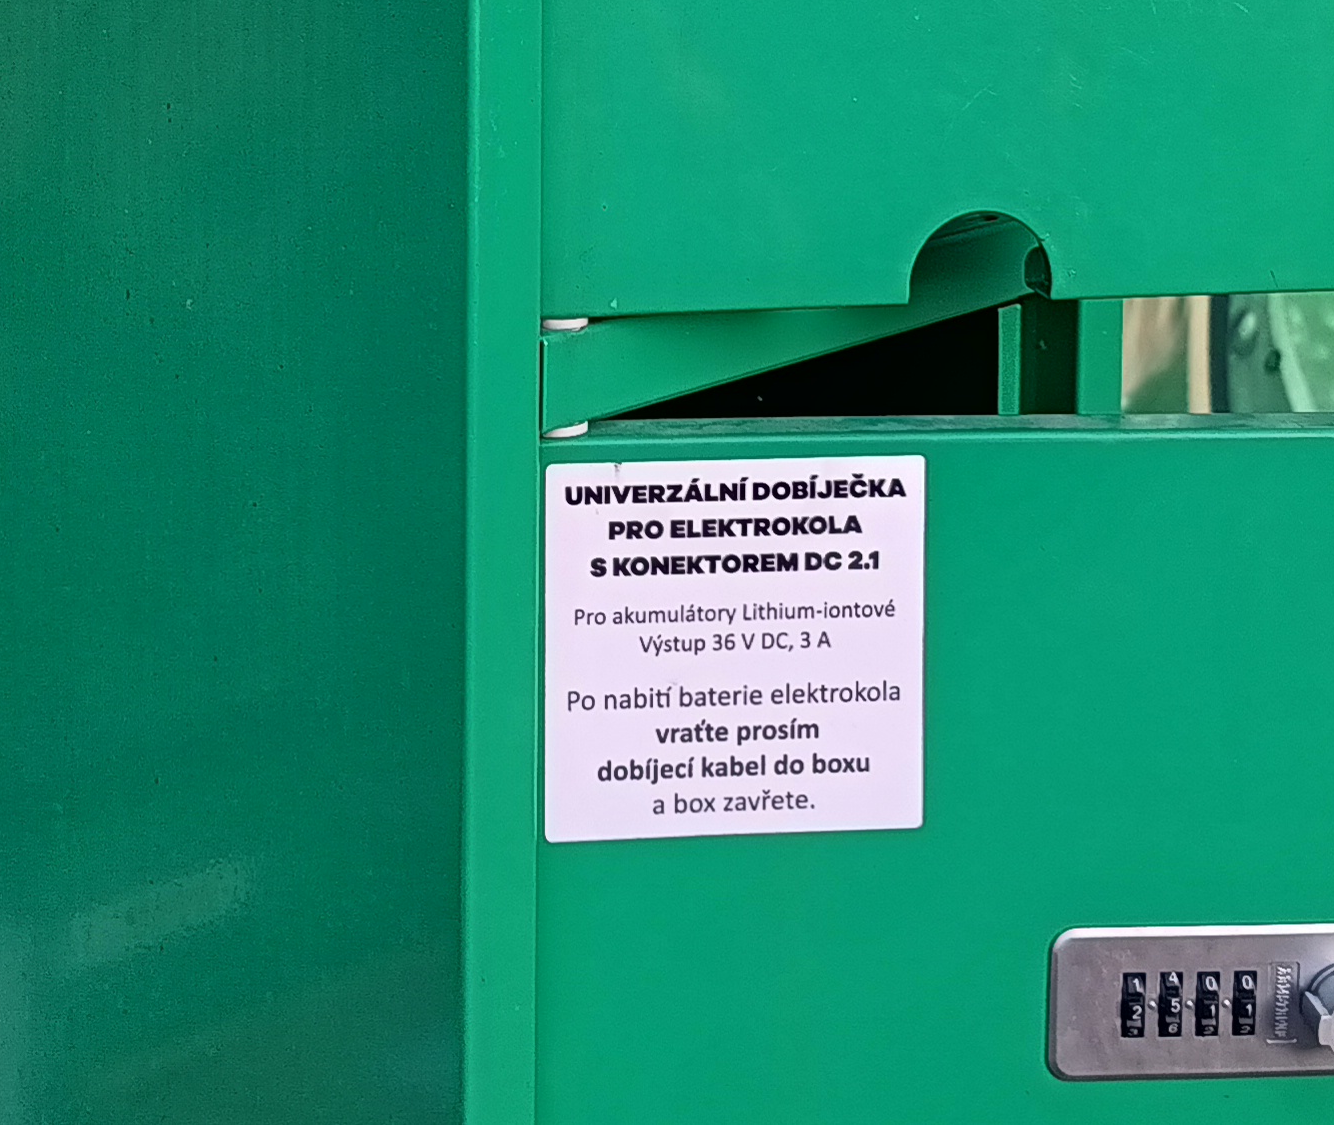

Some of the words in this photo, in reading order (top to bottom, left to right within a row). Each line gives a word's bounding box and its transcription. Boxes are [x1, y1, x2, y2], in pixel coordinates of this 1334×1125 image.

[564, 476, 749, 506] UNIVERZÁLNÍ
[752, 473, 907, 501] DOBÍJEČKA
[608, 519, 665, 541] PRO
[669, 514, 863, 539] ELEKTROKOLA
[589, 557, 608, 578] S
[612, 552, 799, 577] KONEKTOREM
[804, 551, 843, 572] DC
[847, 550, 880, 570] 2.1
[574, 608, 607, 626] Pro
[612, 603, 737, 626] akumulátory
[742, 598, 896, 621] Lithium-iontové
[639, 634, 706, 657] Výstup
[712, 633, 736, 652] 36
[741, 632, 755, 651] V
[761, 631, 794, 652] DC,
[800, 631, 811, 649] 3
[816, 630, 832, 648] A
[567, 690, 596, 712] Po
[604, 686, 672, 711] nabití
[679, 684, 763, 708] baterie
[770, 679, 901, 705] elektrokola
[655, 718, 729, 744] vraťte
[736, 717, 820, 747] prosím
[597, 756, 695, 785] dobíjecí
[701, 754, 766, 778] kabel
[773, 753, 805, 776] do
[812, 752, 870, 775] boxu
[652, 799, 665, 815] a
[674, 792, 716, 814] box
[723, 789, 815, 812] zavřete.
